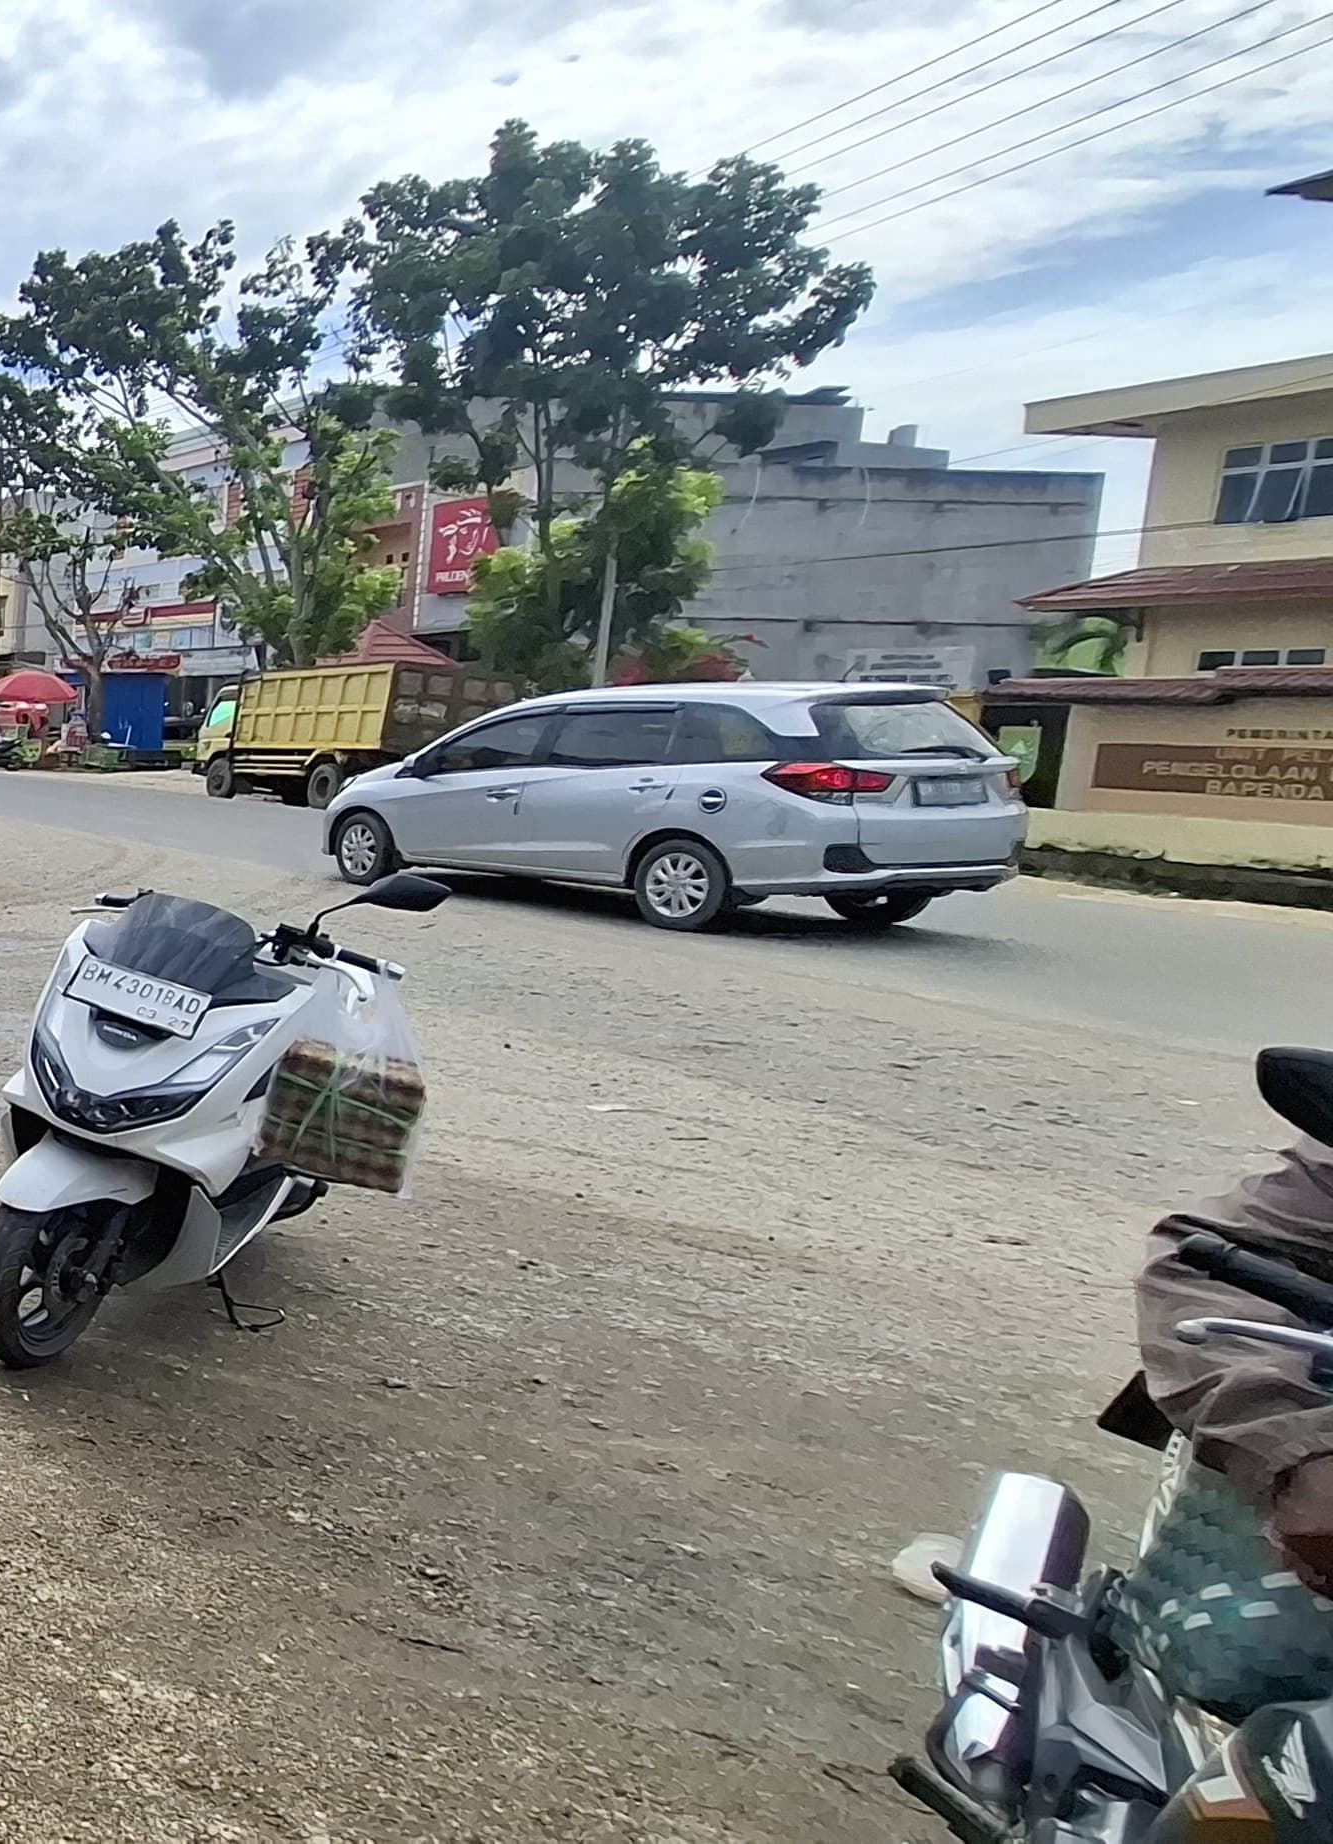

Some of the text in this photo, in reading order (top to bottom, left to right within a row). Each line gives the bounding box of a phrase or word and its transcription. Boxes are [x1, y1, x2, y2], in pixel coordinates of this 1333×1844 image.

[435, 569, 472, 582] PRUDEN
[1142, 761, 1318, 780] PENGELOLAAN
[1205, 780, 1324, 800] BAPENDA
